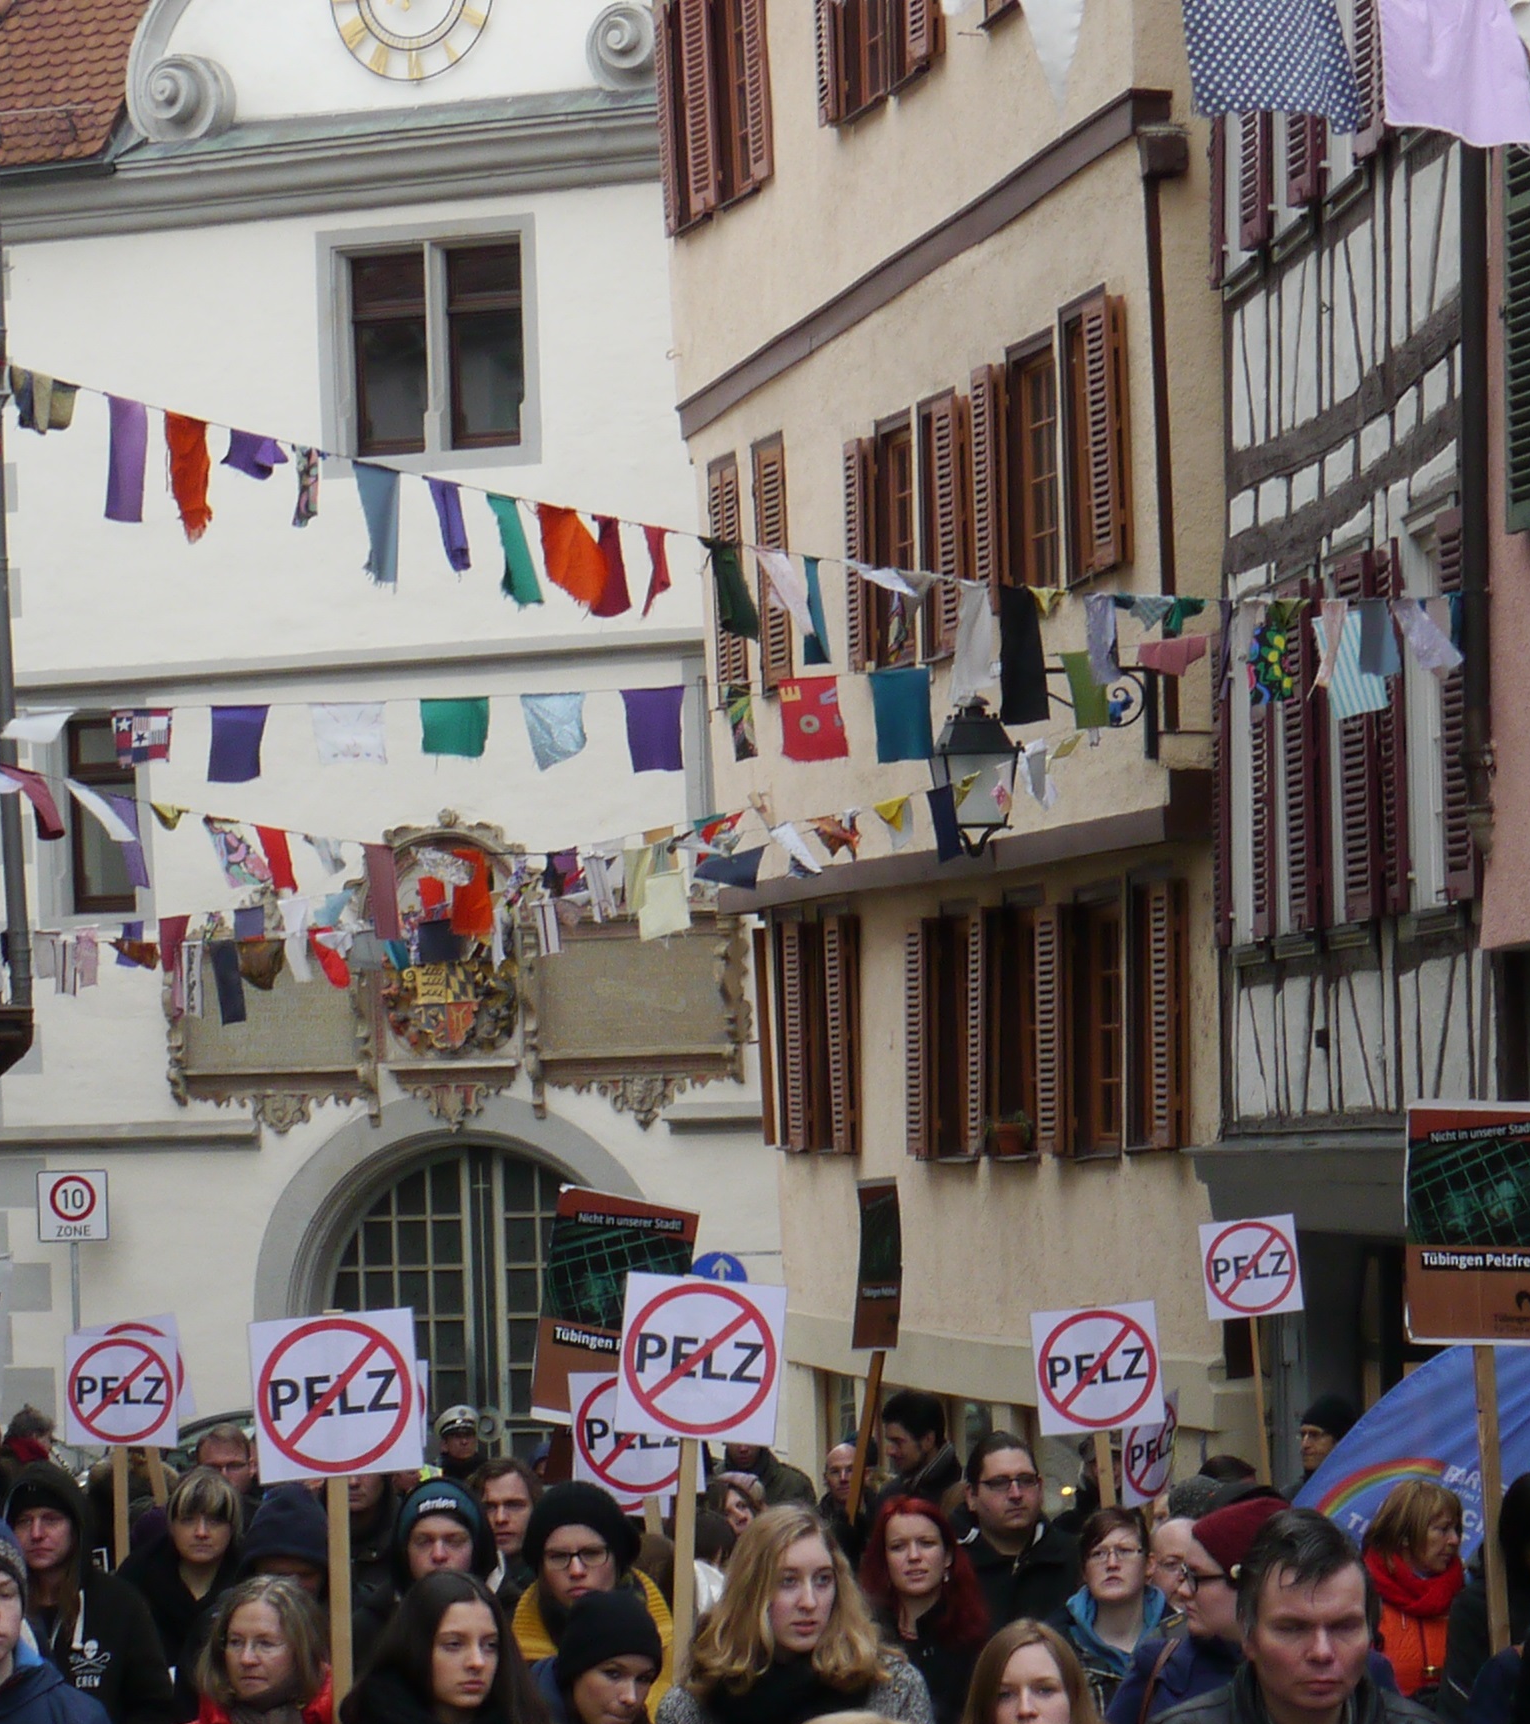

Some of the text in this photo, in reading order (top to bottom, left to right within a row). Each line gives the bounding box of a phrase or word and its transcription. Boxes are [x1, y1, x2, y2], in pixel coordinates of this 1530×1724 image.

[1430, 1132, 1456, 1143] Nicht
[1457, 1131, 1469, 1140] in
[1469, 1127, 1506, 1139] unserer
[61, 1187, 85, 1210] 10
[56, 1224, 92, 1238] ZONE
[577, 1212, 682, 1232] Nicht in unserer Stadt!
[1212, 1249, 1290, 1285] PELZ
[1421, 1252, 1484, 1270] Tübingen
[554, 1326, 614, 1351] Tübingen
[635, 1332, 766, 1385] PELZ
[1048, 1346, 1149, 1389] PELZ
[76, 1375, 166, 1406] PELZ
[268, 1367, 401, 1422] PELZ
[75, 1675, 101, 1688] CREW
